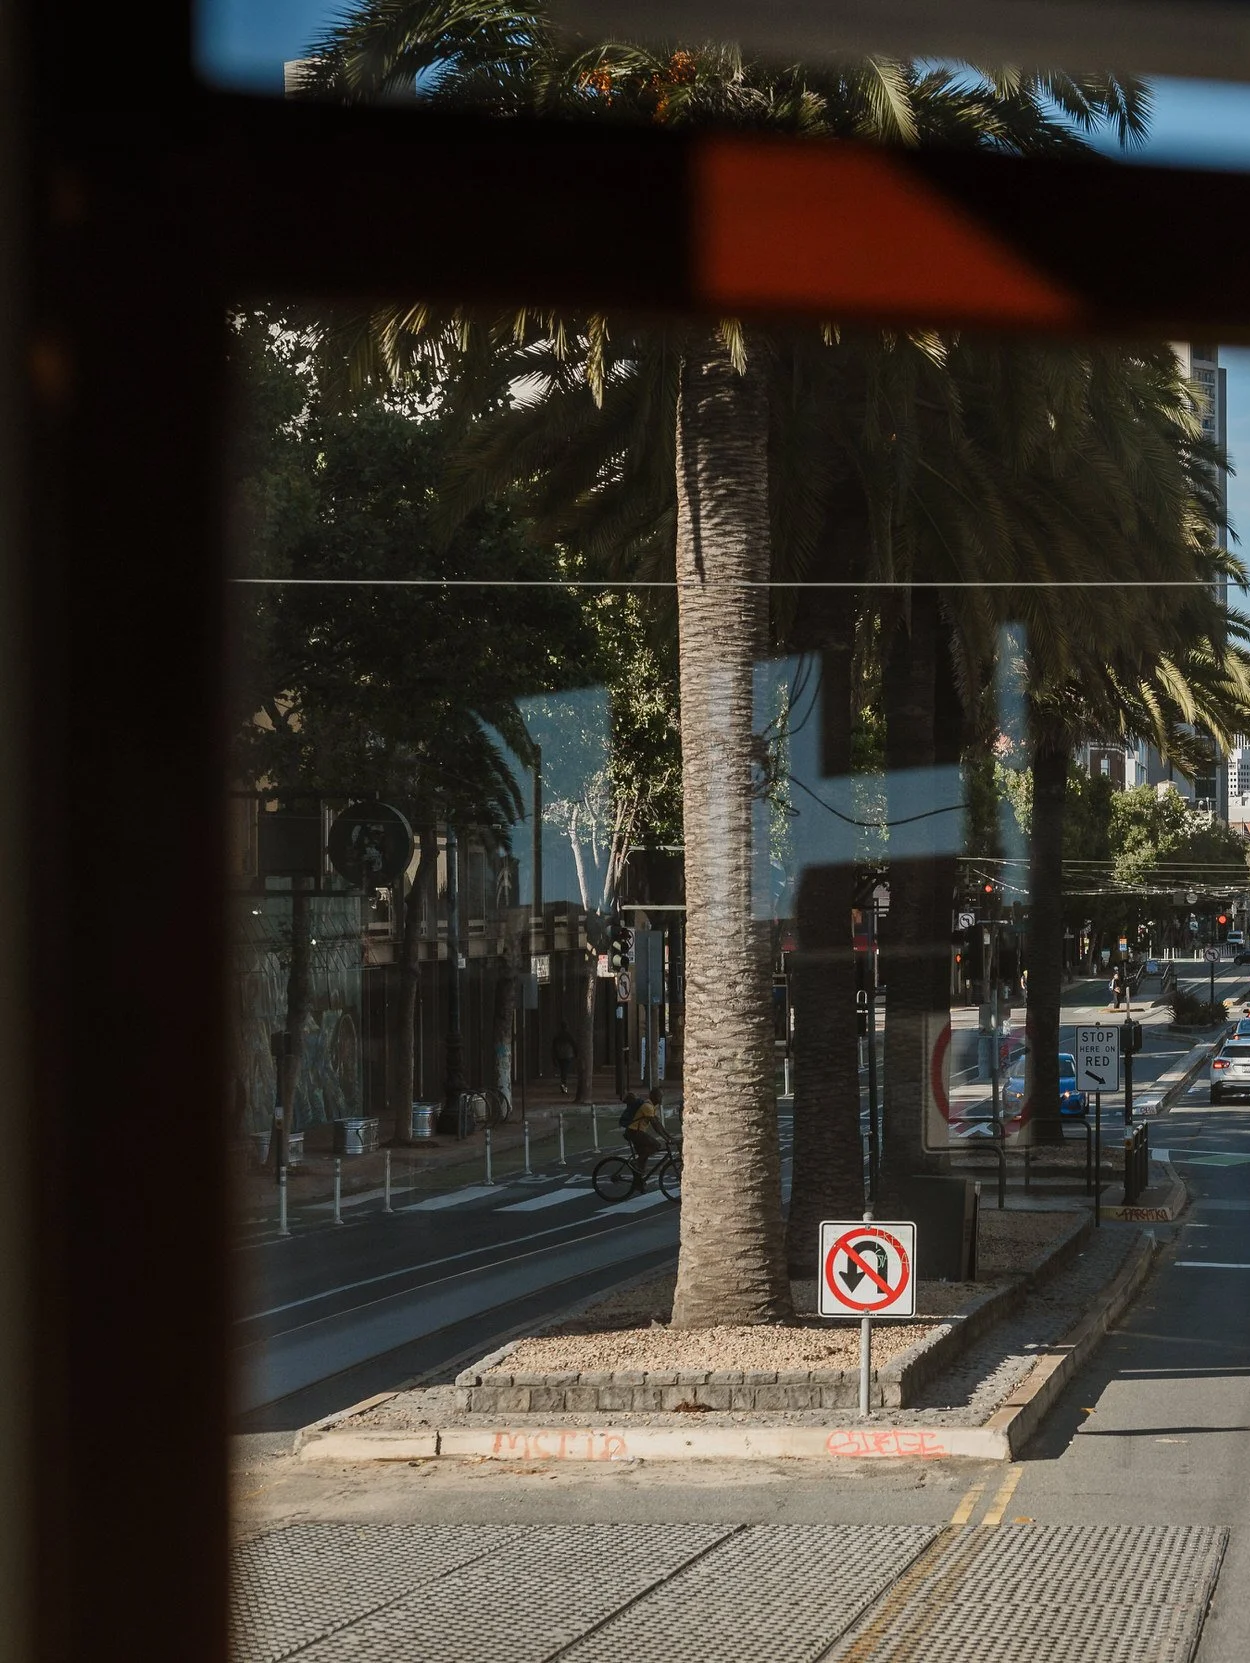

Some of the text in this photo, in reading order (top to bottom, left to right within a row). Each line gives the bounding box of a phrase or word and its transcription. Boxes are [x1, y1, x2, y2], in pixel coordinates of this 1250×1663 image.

[1081, 1031, 1114, 1042] STOP
[1079, 1045, 1116, 1053] HERE ON
[1085, 1056, 1110, 1067] RED
